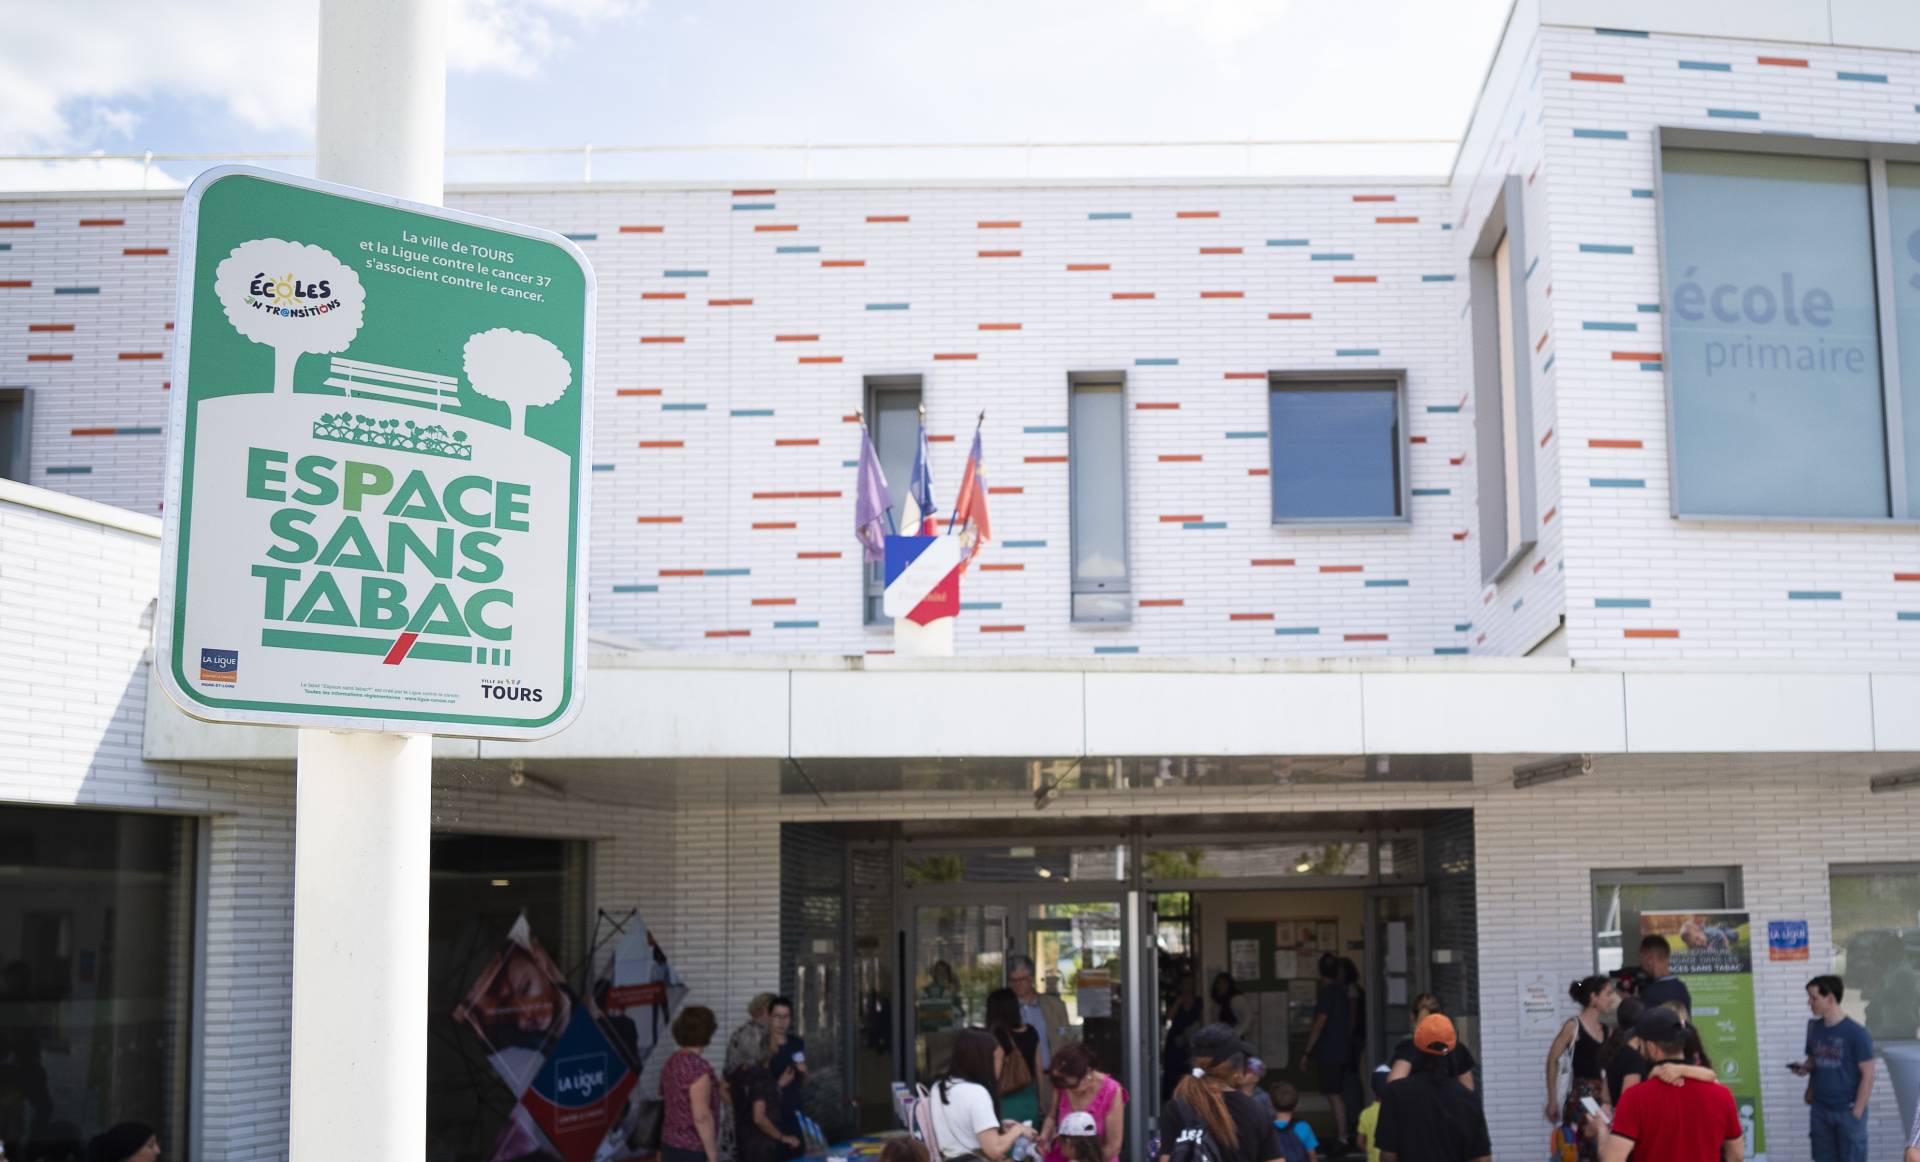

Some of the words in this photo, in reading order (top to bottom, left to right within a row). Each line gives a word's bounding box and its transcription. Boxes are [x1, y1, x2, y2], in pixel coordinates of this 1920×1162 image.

[359, 240, 374, 251] et
[377, 241, 389, 255] la
[392, 245, 430, 263] Ligue
[432, 254, 475, 272] contre
[478, 263, 489, 275] le
[491, 268, 534, 284] cancer
[536, 275, 552, 288] 37
[403, 230, 418, 244] La
[421, 235, 449, 250] ville
[451, 241, 468, 255] de
[470, 244, 514, 264] TOURS
[366, 258, 439, 282] s'associent
[441, 274, 484, 291] contre
[486, 281, 498, 293] le
[500, 286, 545, 303] cancer.
[1672, 265, 1835, 327] école
[1704, 334, 1865, 377] primaire
[246, 446, 531, 533] ESPACE
[265, 507, 504, 584] SANS
[251, 564, 514, 642] TABAC
[481, 684, 543, 702] TOURS
[557, 1076, 573, 1092] LA
